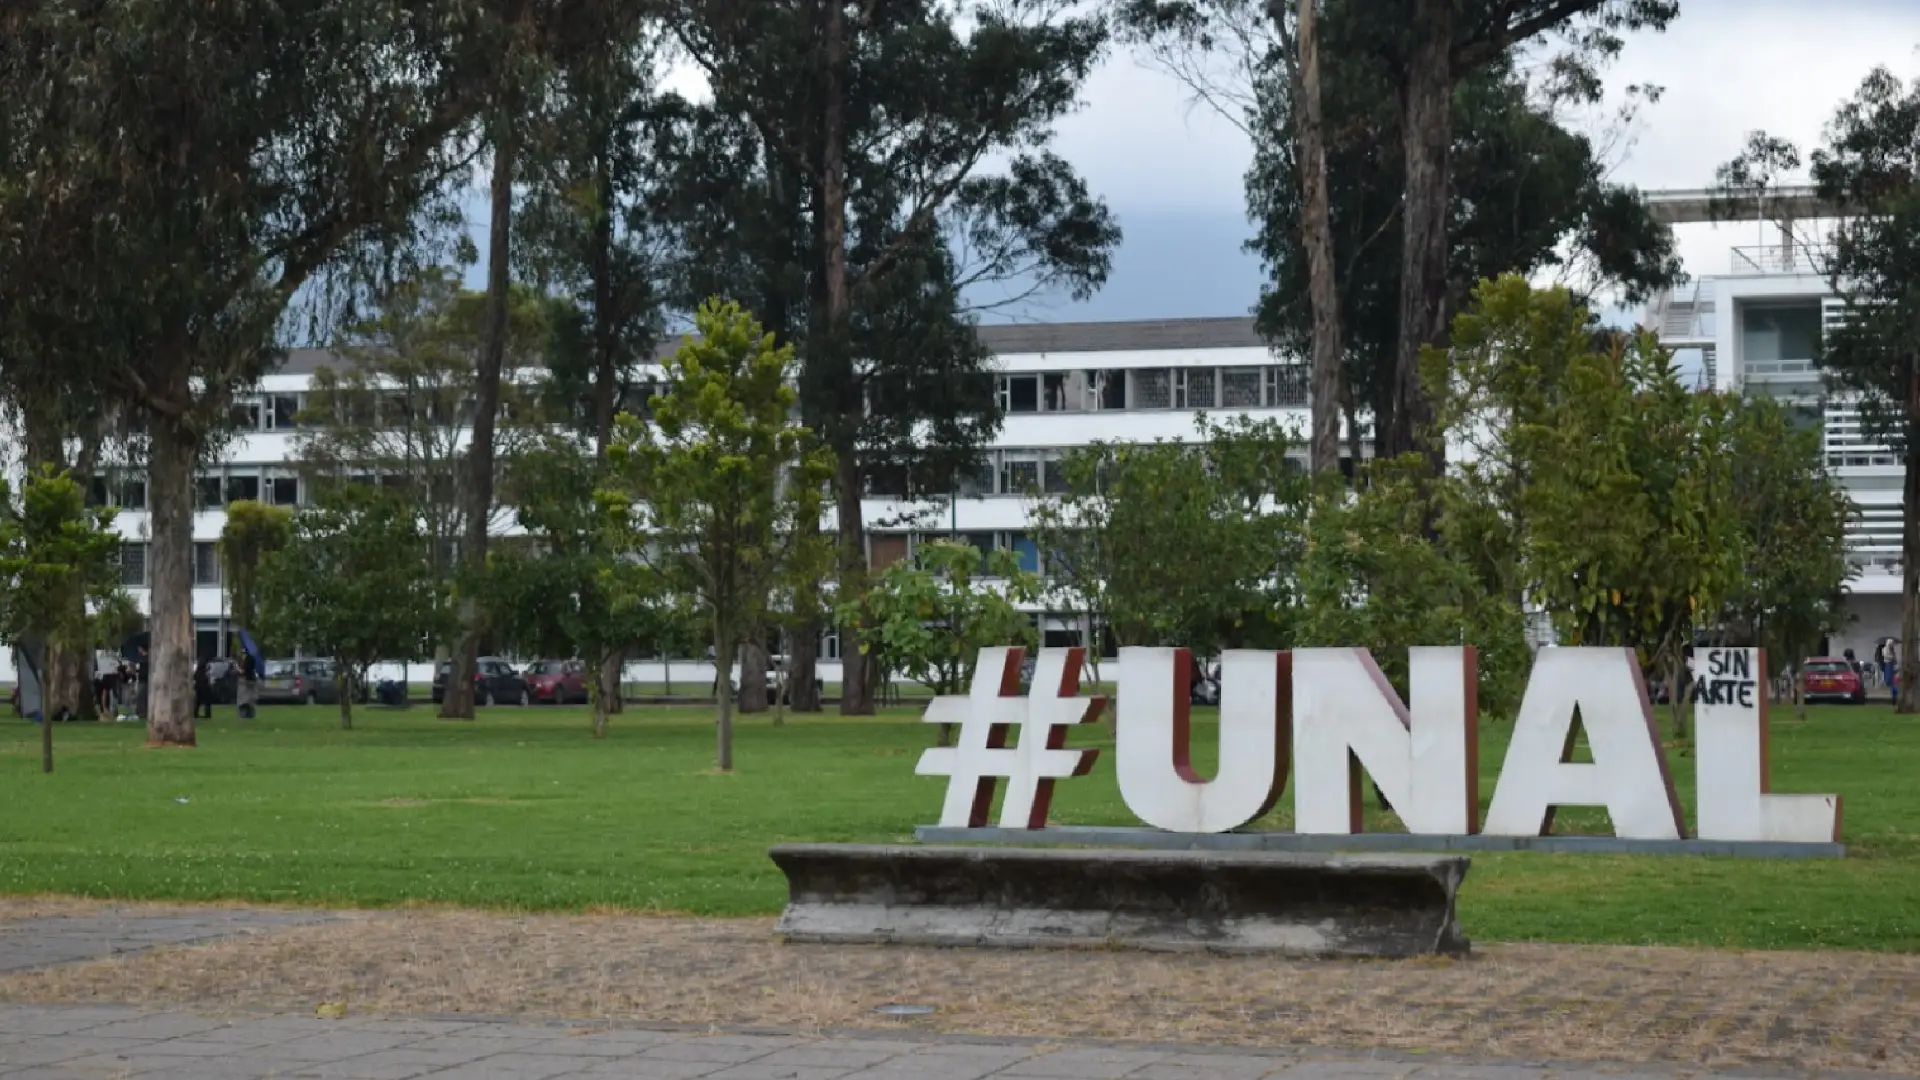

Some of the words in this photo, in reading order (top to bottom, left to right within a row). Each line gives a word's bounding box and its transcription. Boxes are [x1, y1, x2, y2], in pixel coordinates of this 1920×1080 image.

[1708, 648, 1749, 679] SIN
[1692, 675, 1756, 708] ARTE
[914, 645, 1839, 844] #UNAL
